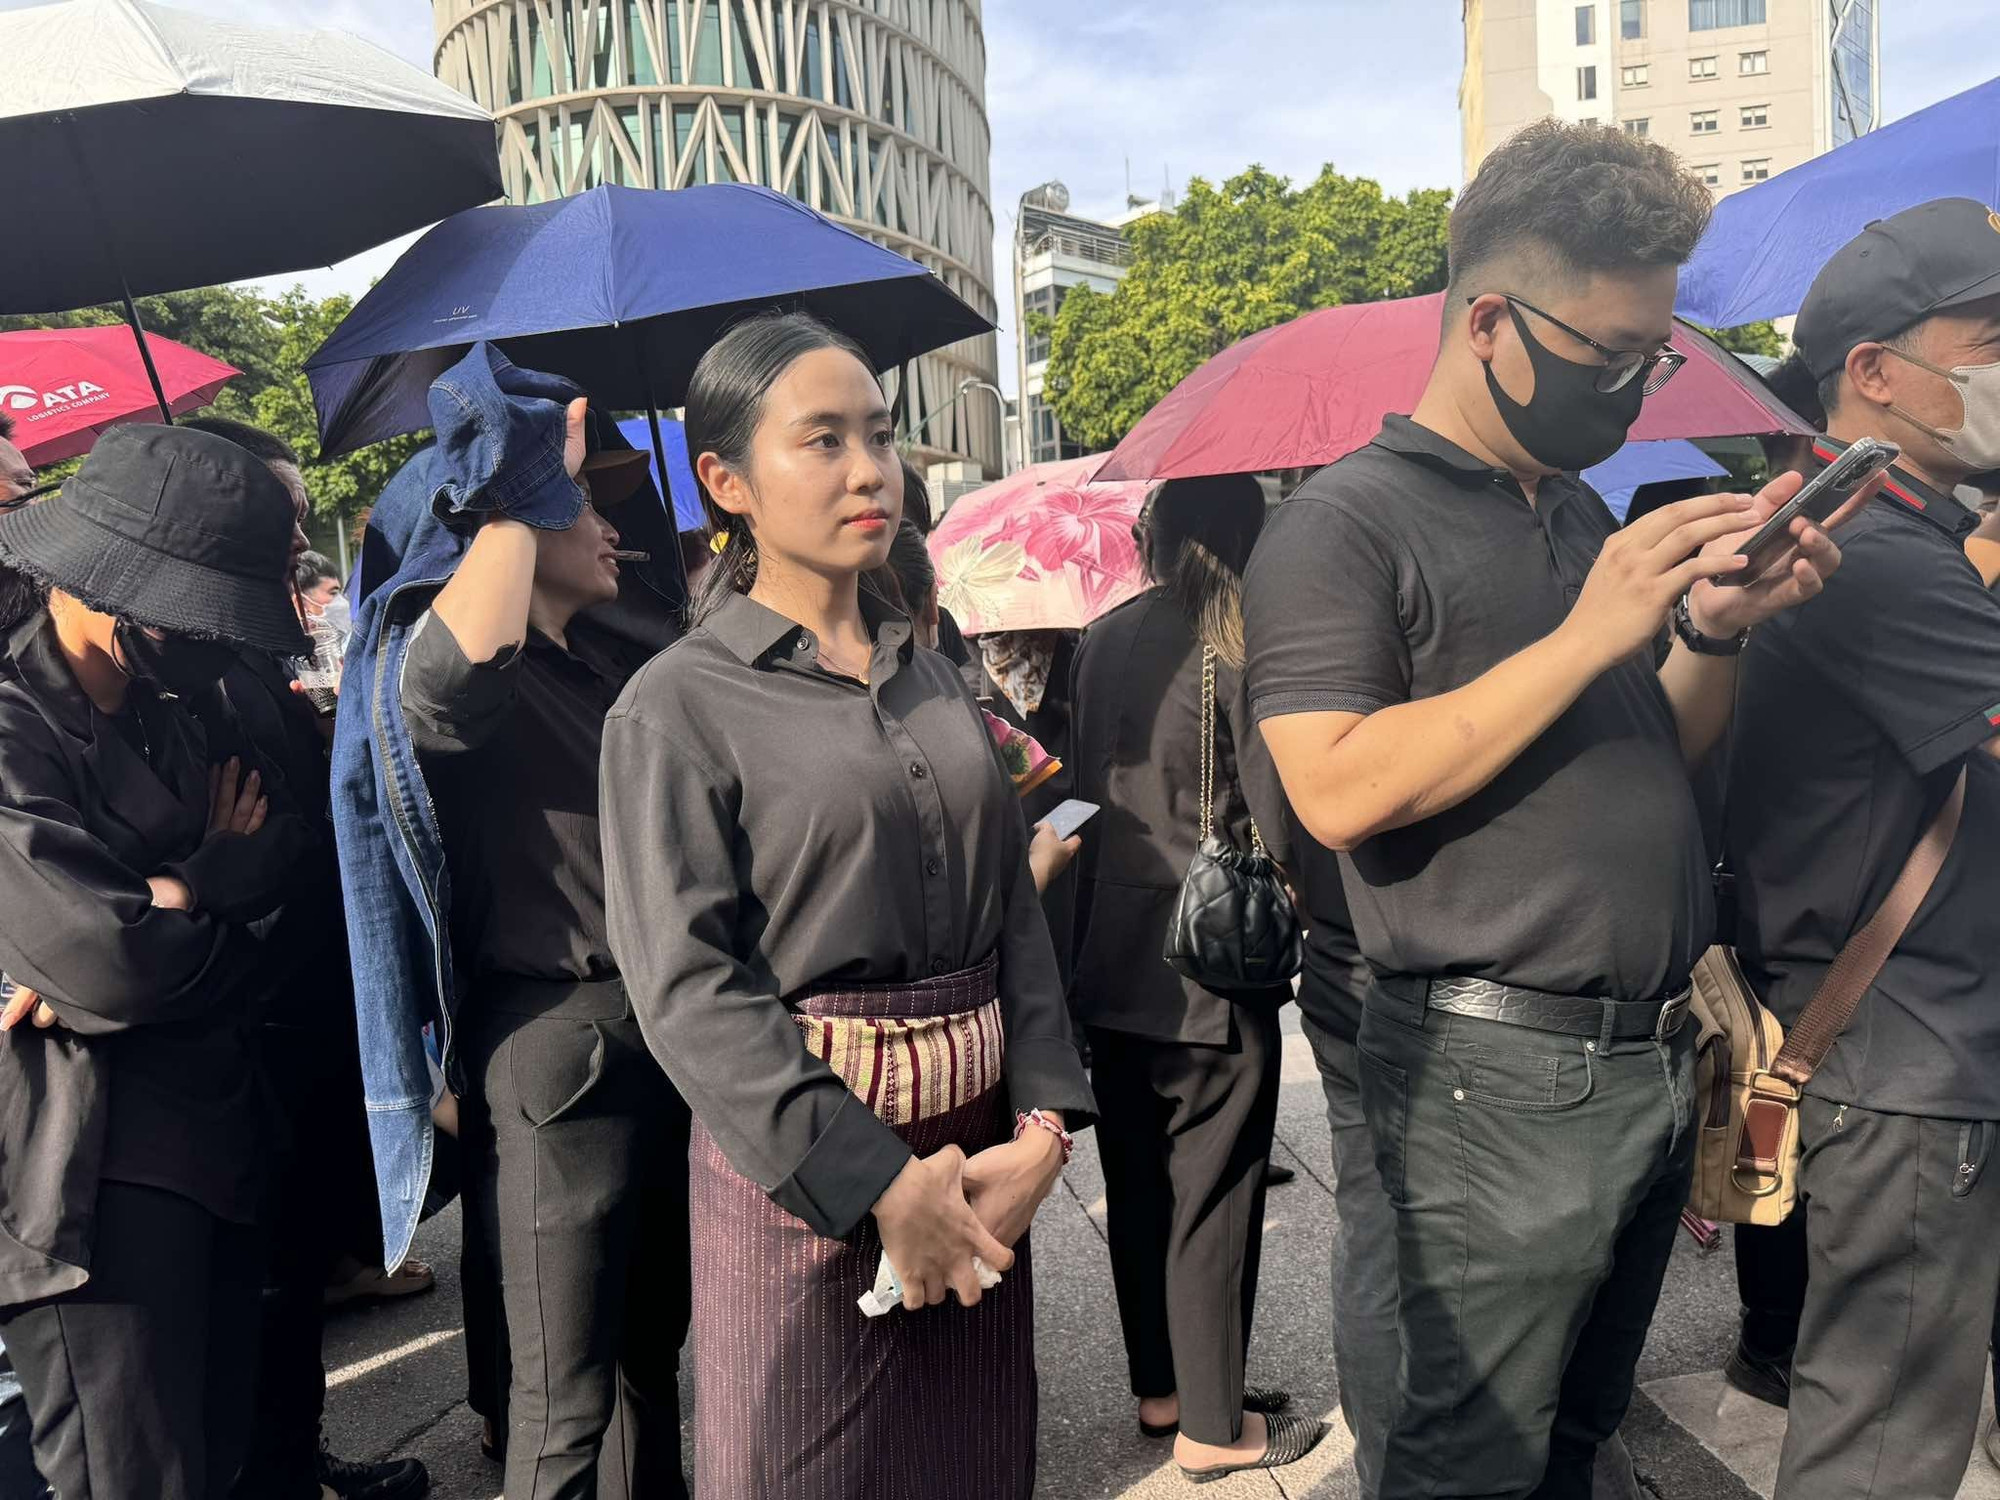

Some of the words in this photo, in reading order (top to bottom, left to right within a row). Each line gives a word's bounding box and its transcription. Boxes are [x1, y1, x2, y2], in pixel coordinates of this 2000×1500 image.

[453, 305, 470, 315] UV
[27, 404, 71, 422] LOGISTICS
[71, 392, 110, 408] COMPANY
[42, 381, 104, 408] ATA
